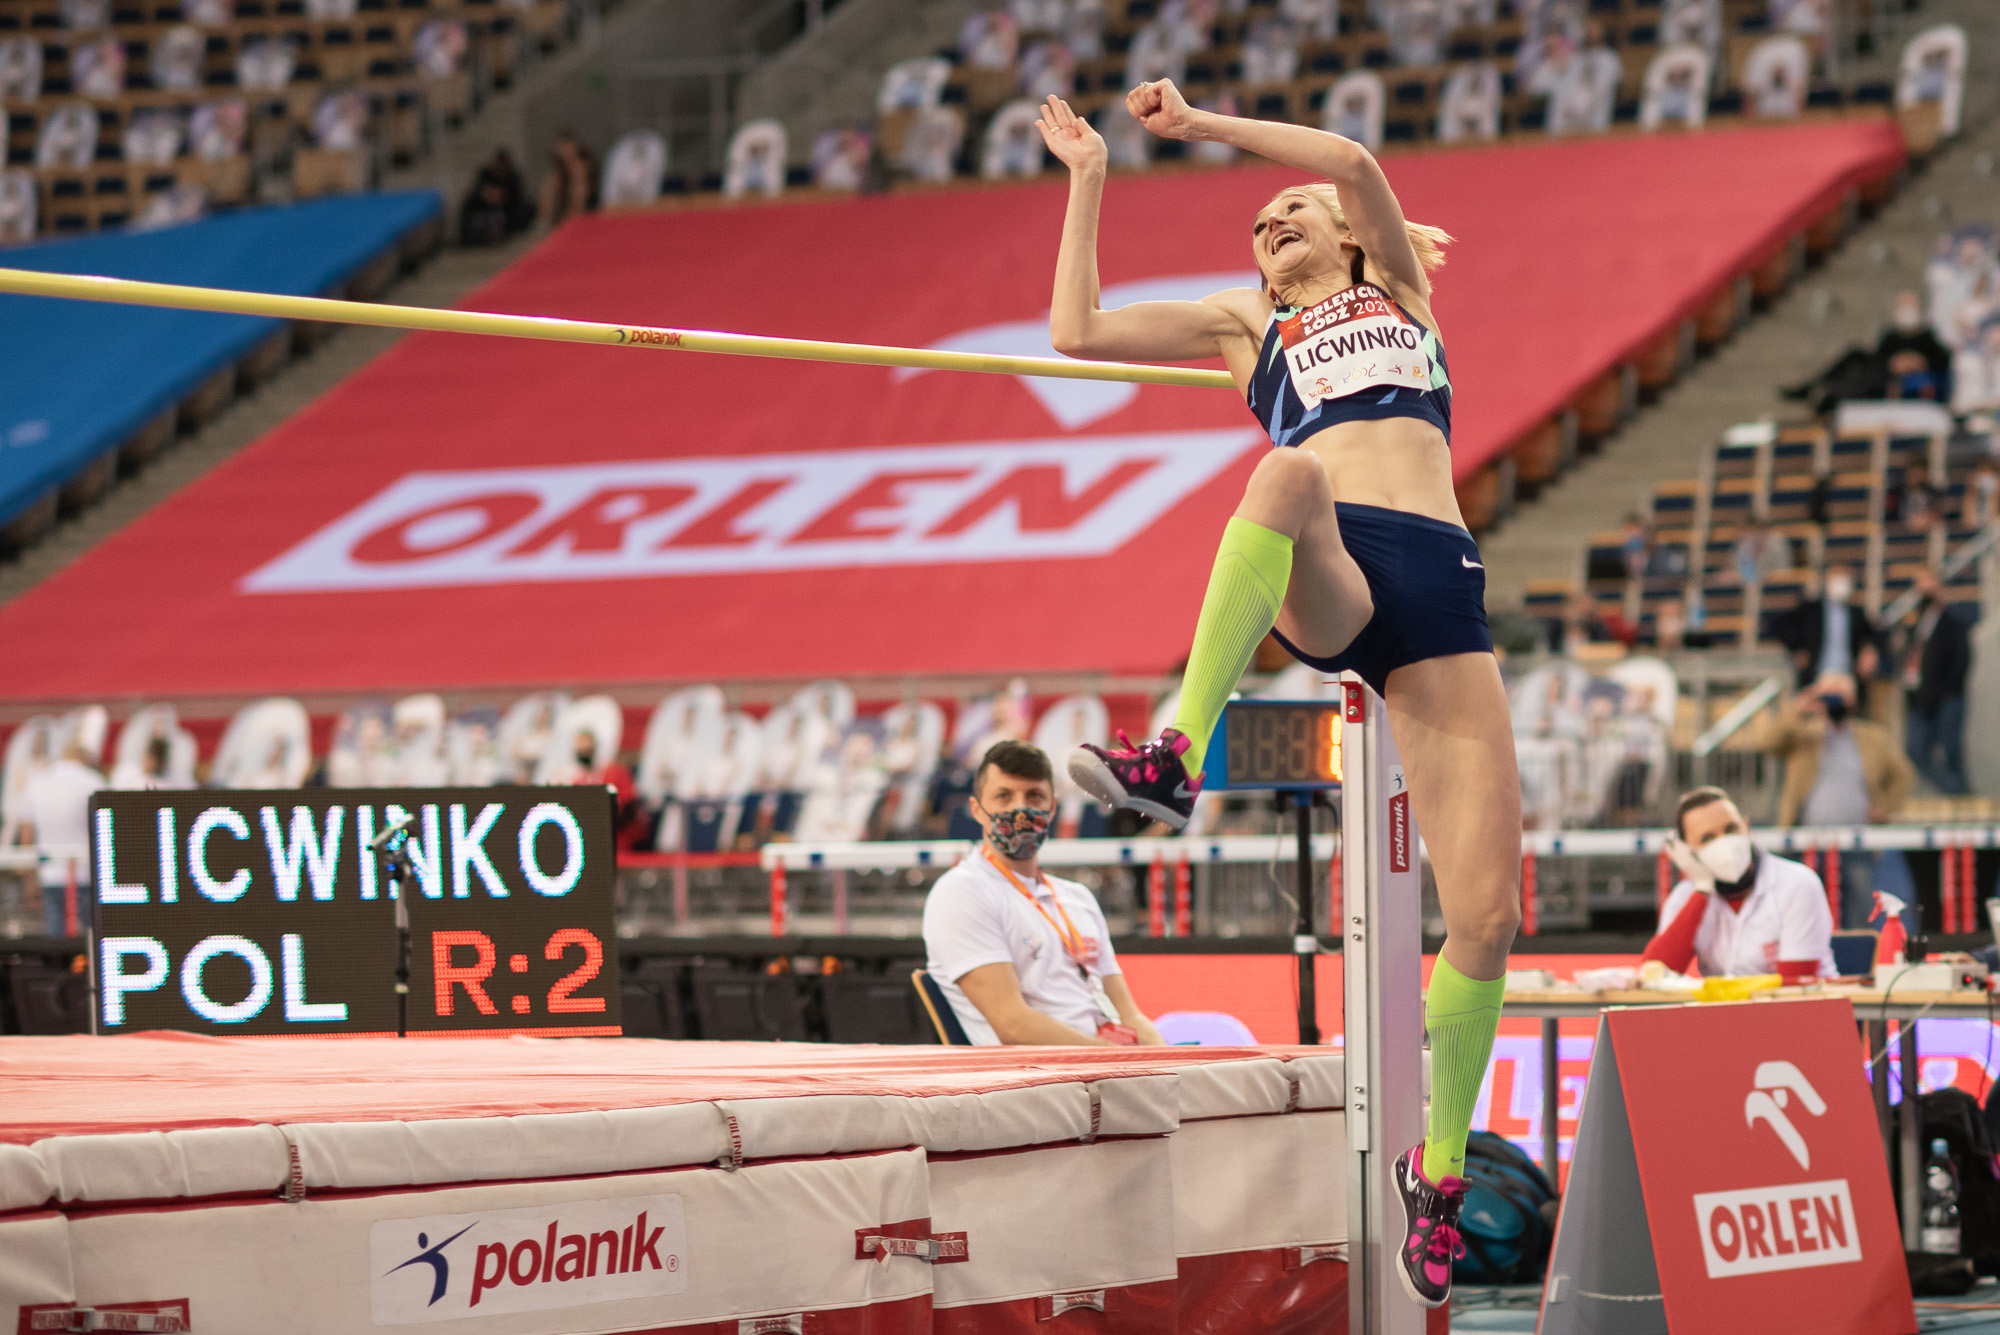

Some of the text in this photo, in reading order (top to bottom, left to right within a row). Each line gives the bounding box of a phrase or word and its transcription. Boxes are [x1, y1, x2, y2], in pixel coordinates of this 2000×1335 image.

[627, 330, 682, 346] polanik
[1301, 288, 1355, 324] ORLEN
[1304, 306, 1350, 337] ŁÓDŹ
[1294, 325, 1417, 374] LIĆWINKO
[344, 456, 1176, 569] ORLEN
[95, 802, 584, 903] LICWINKO
[1394, 801, 1407, 867] polanik
[100, 928, 606, 1025] POL R:2
[469, 1210, 666, 1308] polanik
[1710, 1194, 1848, 1263] ORLEN
